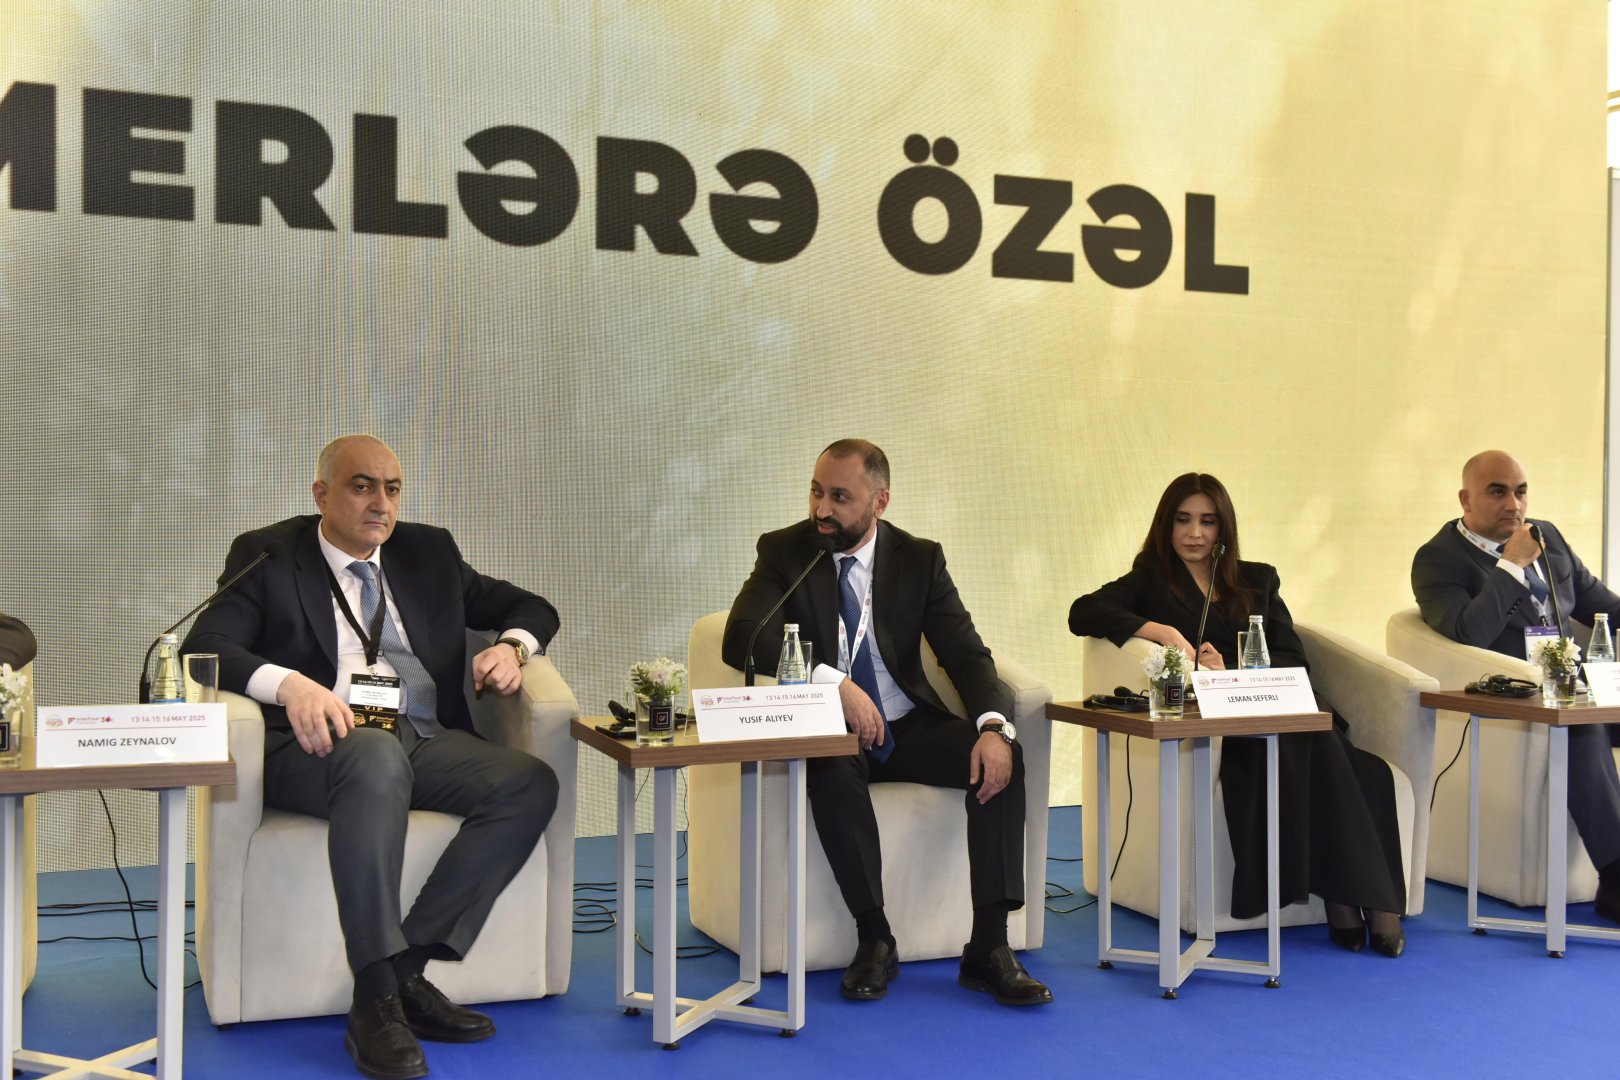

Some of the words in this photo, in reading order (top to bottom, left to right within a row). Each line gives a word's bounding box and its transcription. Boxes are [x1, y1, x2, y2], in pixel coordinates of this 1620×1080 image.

[877, 133, 1249, 295] ÖZƏL
[739, 716, 762, 724] YUSIF
[766, 714, 794, 722] ALIYEV
[78, 739, 117, 747] NAMIG
[120, 737, 176, 746] ZEYNALOV
